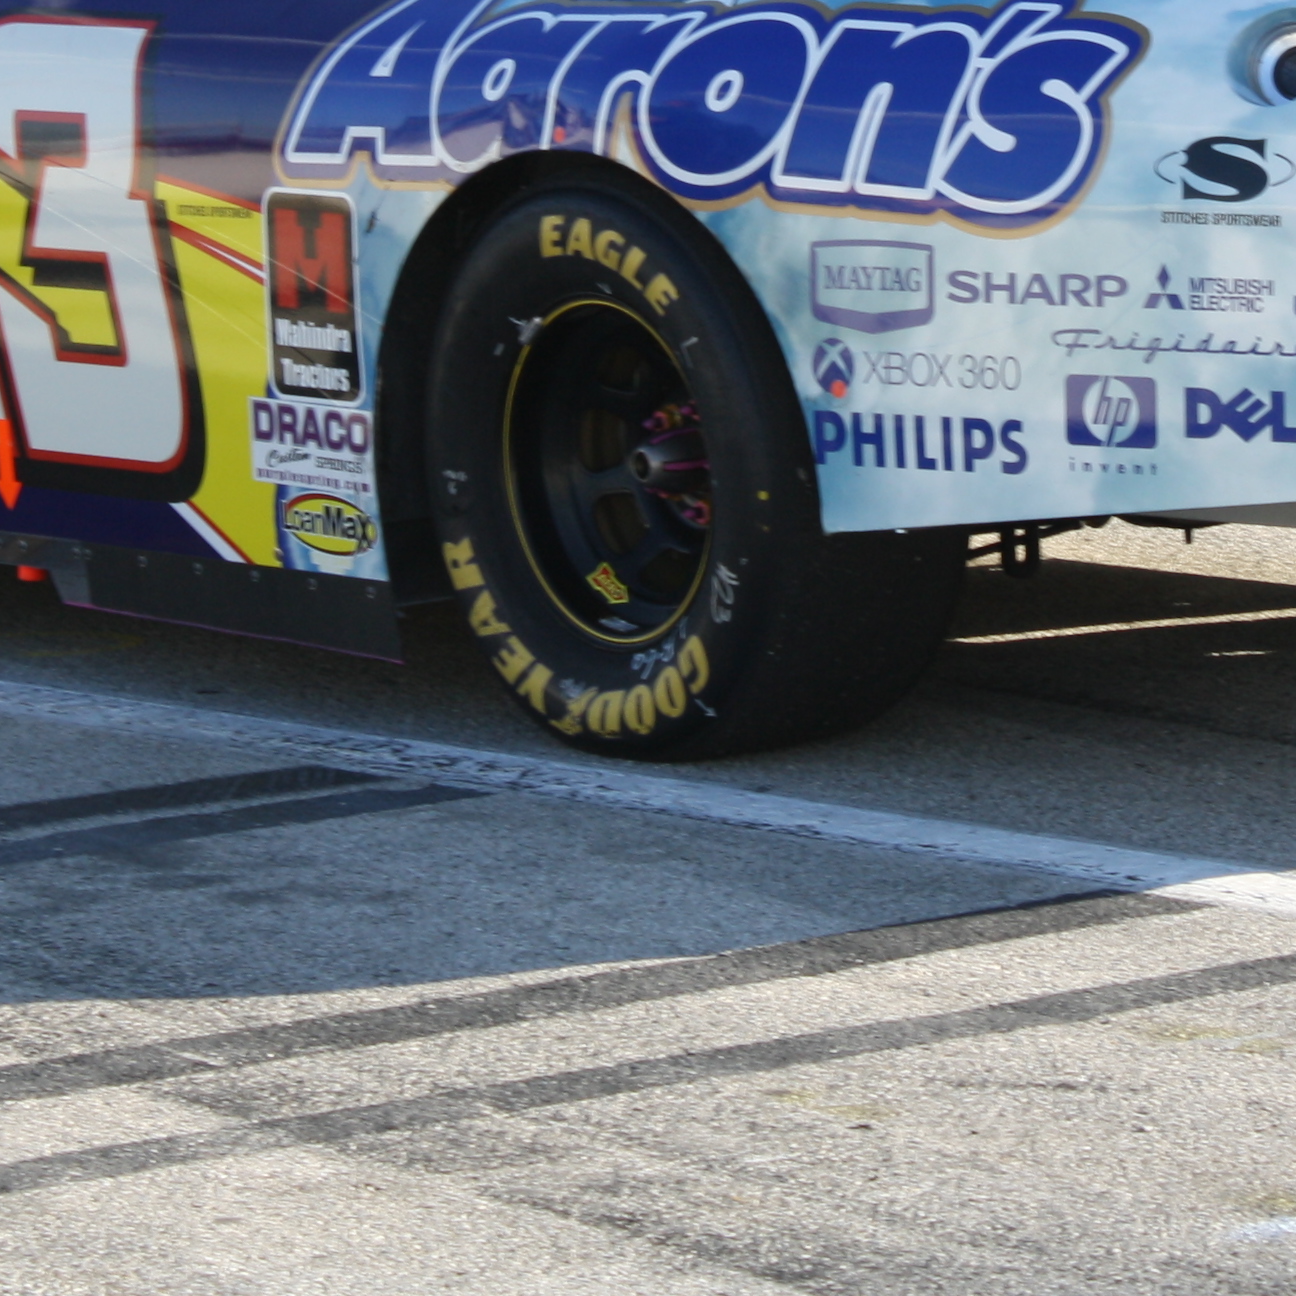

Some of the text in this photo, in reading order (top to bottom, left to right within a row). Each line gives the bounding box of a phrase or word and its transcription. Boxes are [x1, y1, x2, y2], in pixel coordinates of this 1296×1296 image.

[539, 214, 680, 316] EAGLE
[822, 265, 923, 293] MAYTAG
[946, 269, 1129, 307] SHARP
[1189, 276, 1275, 296] MITSUBISHI
[1189, 296, 1265, 313] ELECTRIC
[274, 317, 352, 354] Mahindra
[280, 357, 351, 393] Tractors
[862, 350, 1022, 391] XBOX 360
[253, 400, 370, 455] DRACO
[813, 409, 1030, 476] PHILIPS
[1067, 456, 1160, 477] invent
[281, 502, 378, 553] LoanMax
